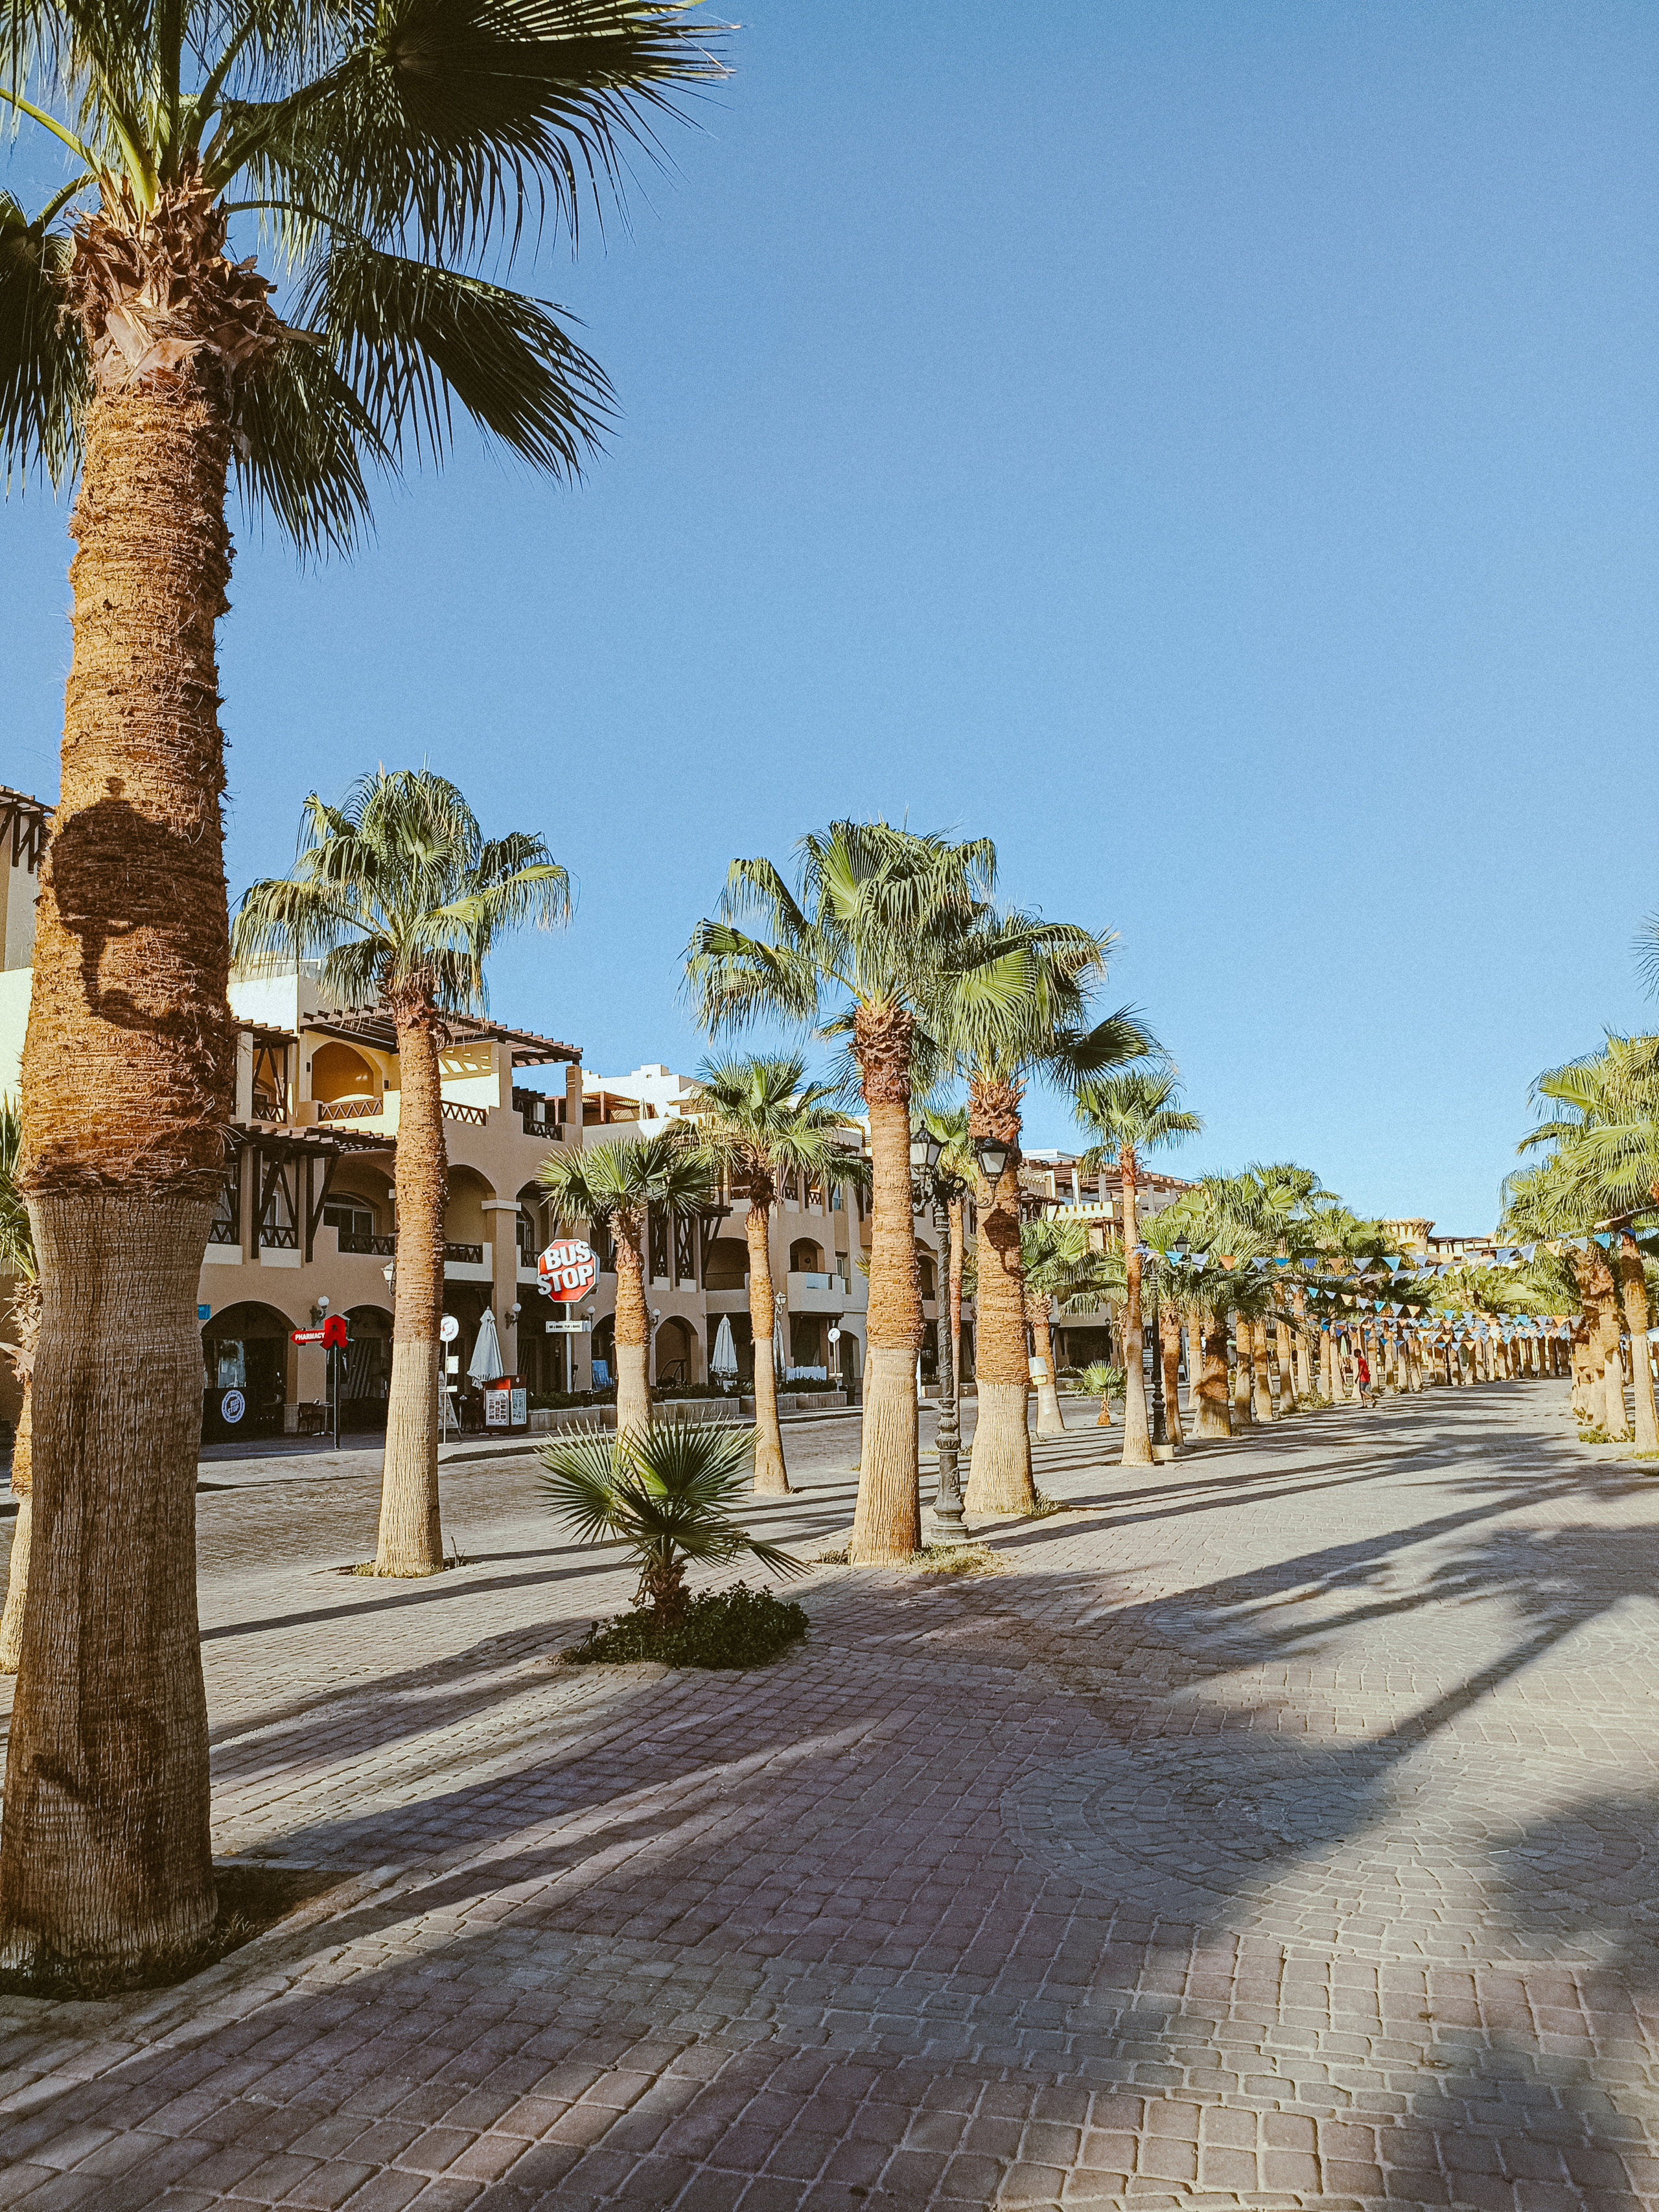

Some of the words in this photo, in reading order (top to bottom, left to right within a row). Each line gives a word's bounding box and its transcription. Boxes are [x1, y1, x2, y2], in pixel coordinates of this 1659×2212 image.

[544, 1240, 592, 1271] BUS
[537, 1264, 594, 1295] STOP
[227, 1404, 239, 1414] STOP
